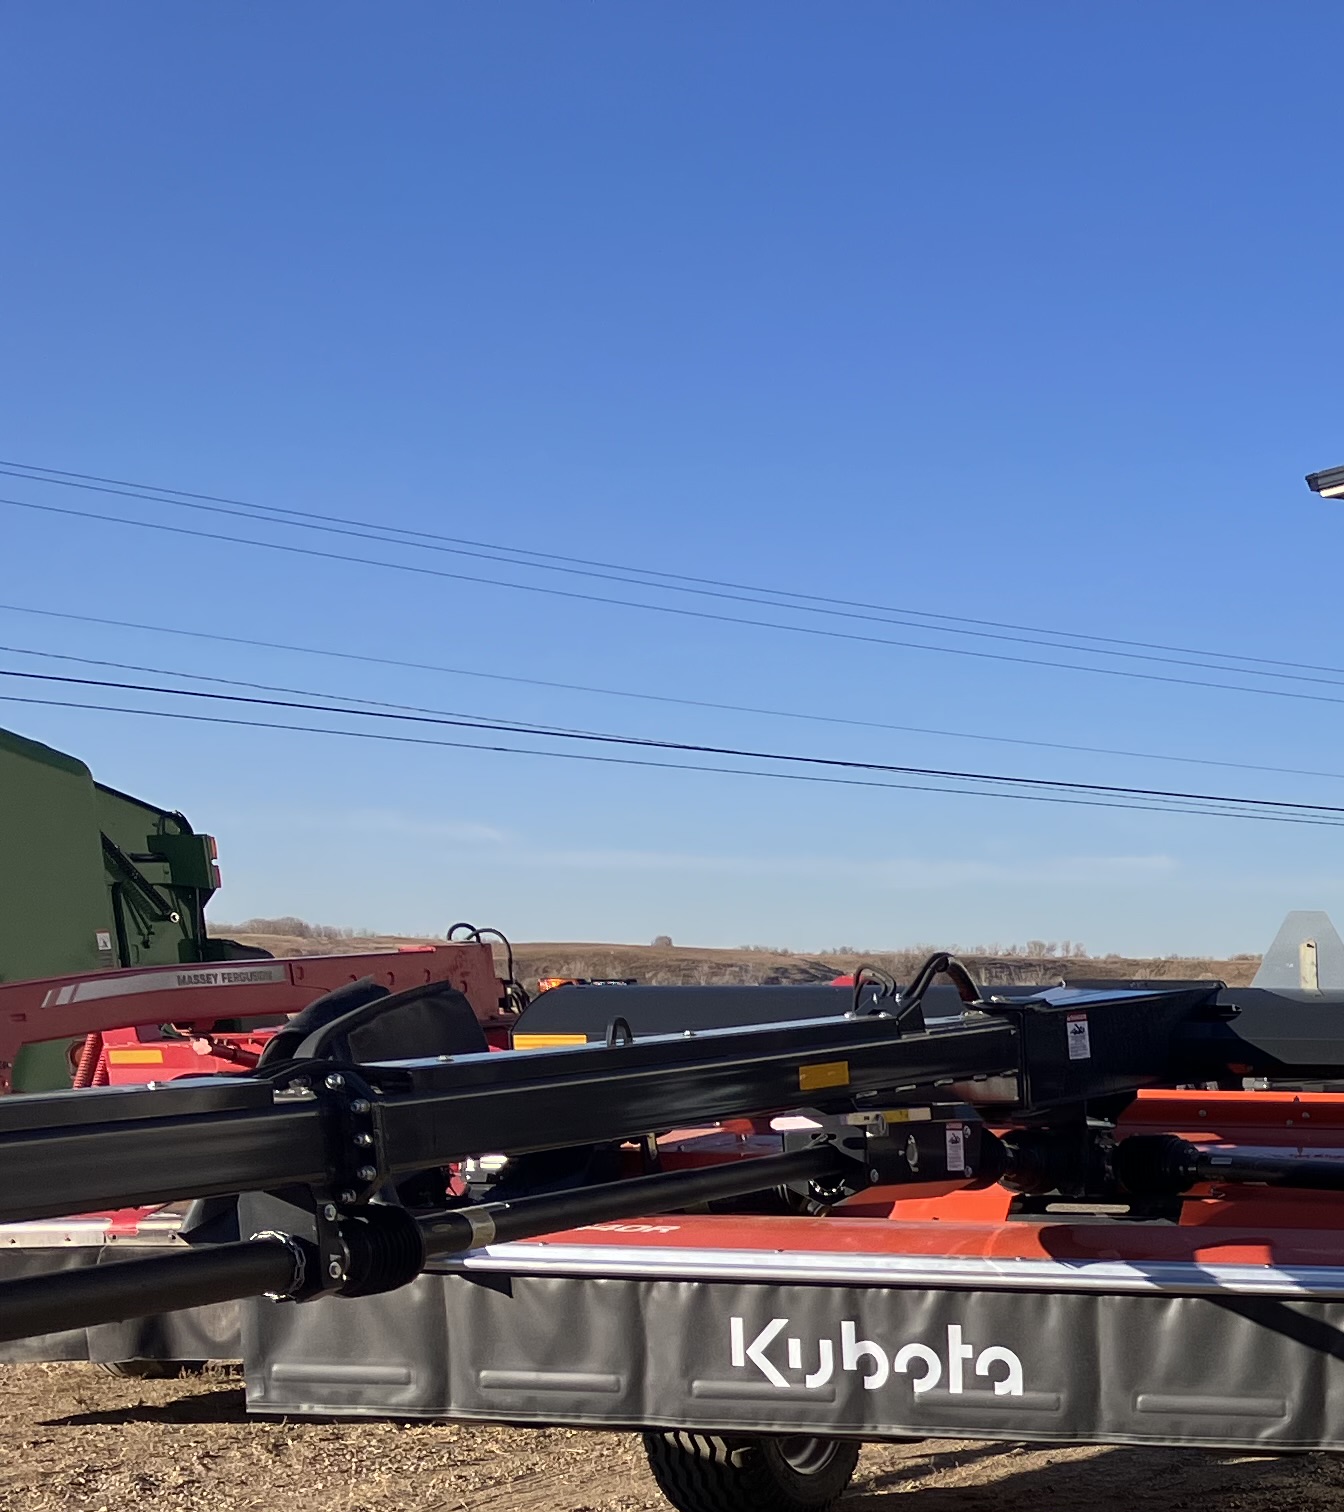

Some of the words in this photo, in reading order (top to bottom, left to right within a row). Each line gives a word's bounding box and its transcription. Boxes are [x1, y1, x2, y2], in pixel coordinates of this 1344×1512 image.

[177, 973, 218, 986] MASSEY
[221, 970, 272, 983] FERGUSON
[730, 1316, 1023, 1396] Kubota
